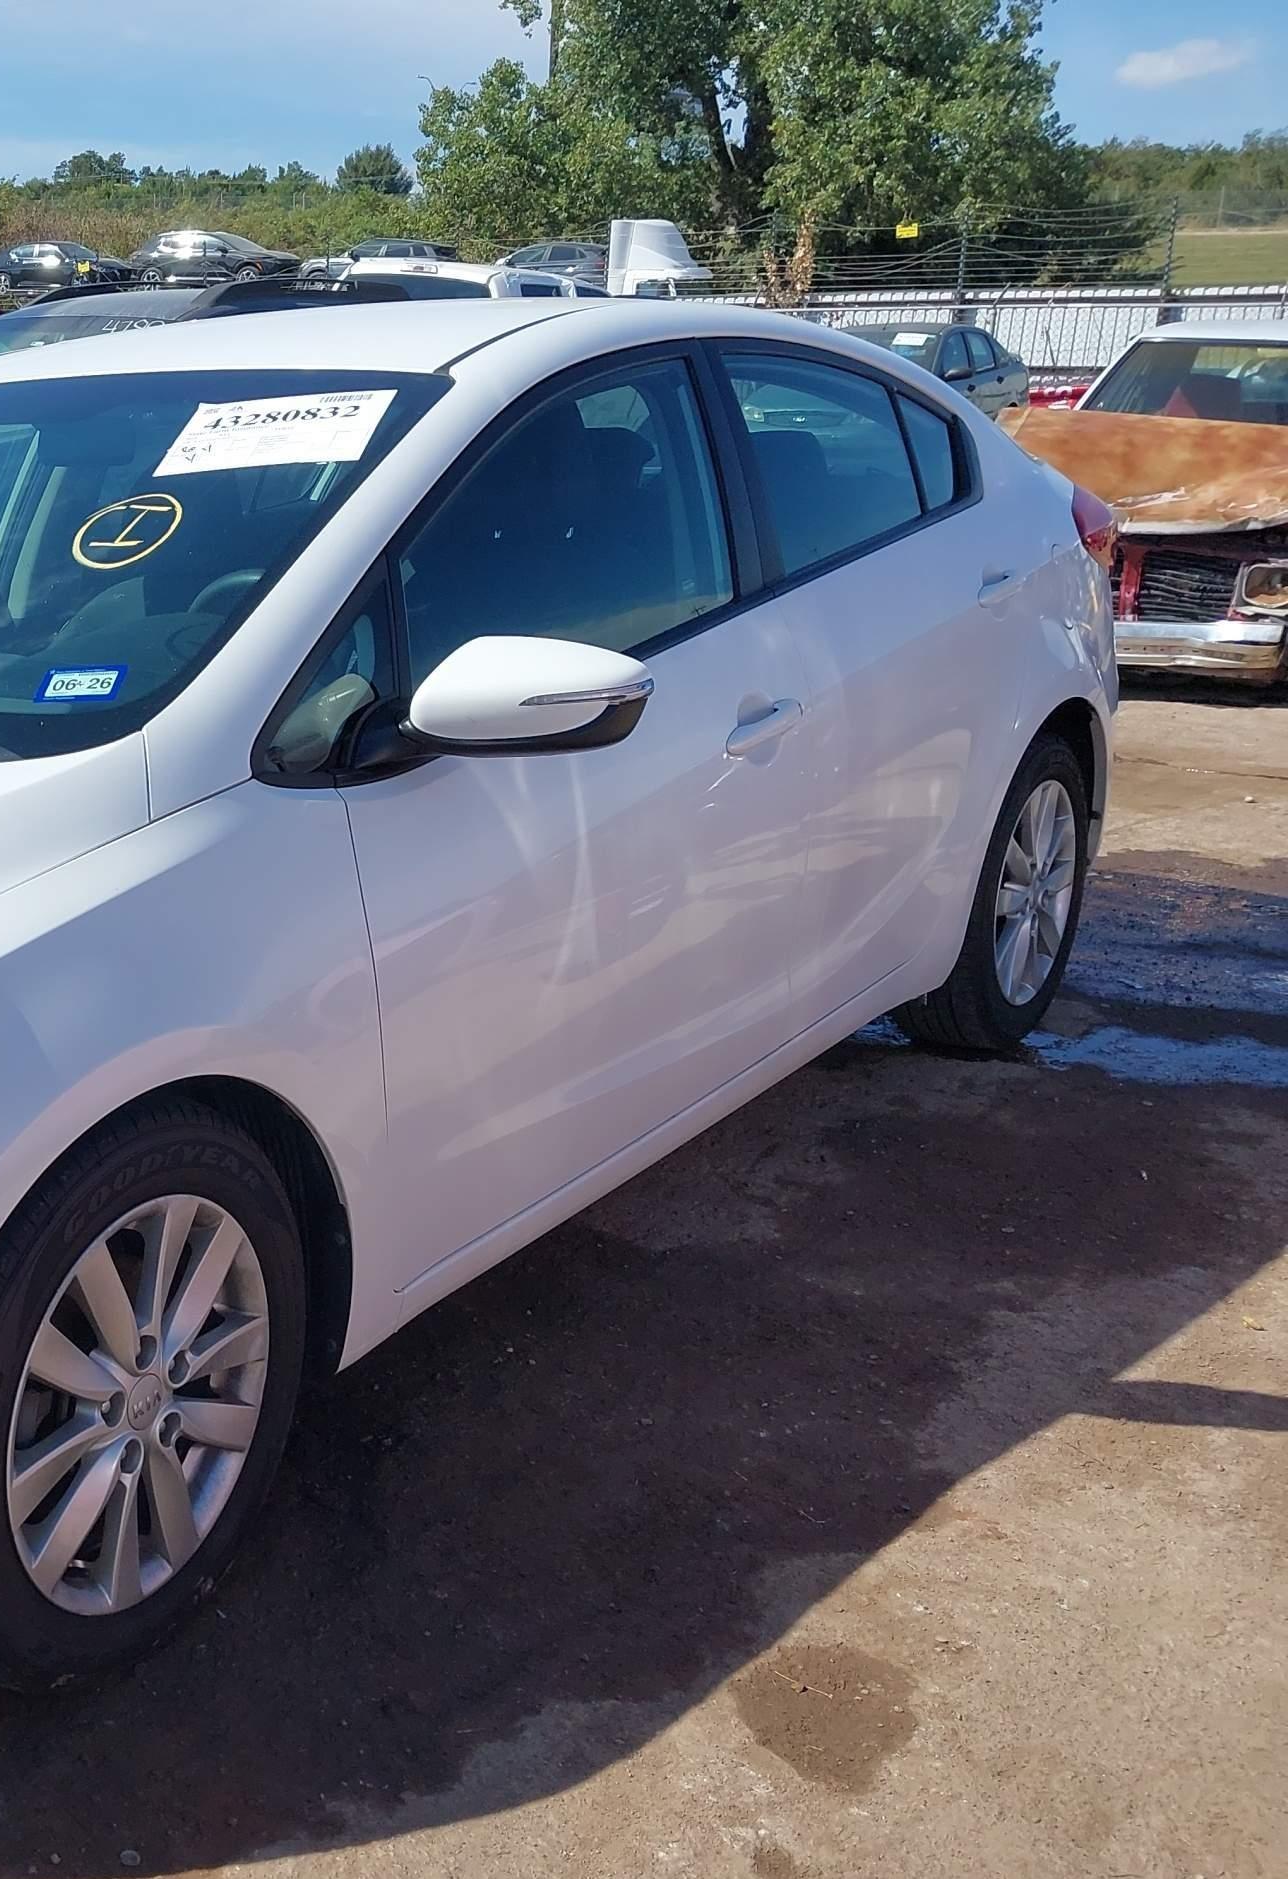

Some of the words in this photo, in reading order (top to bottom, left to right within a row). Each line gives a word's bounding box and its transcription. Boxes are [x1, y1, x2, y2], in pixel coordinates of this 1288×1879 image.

[203, 405, 360, 429] 43280832
[52, 678, 78, 691] 06
[86, 677, 113, 689] 26
[132, 1390, 161, 1419] KIA
